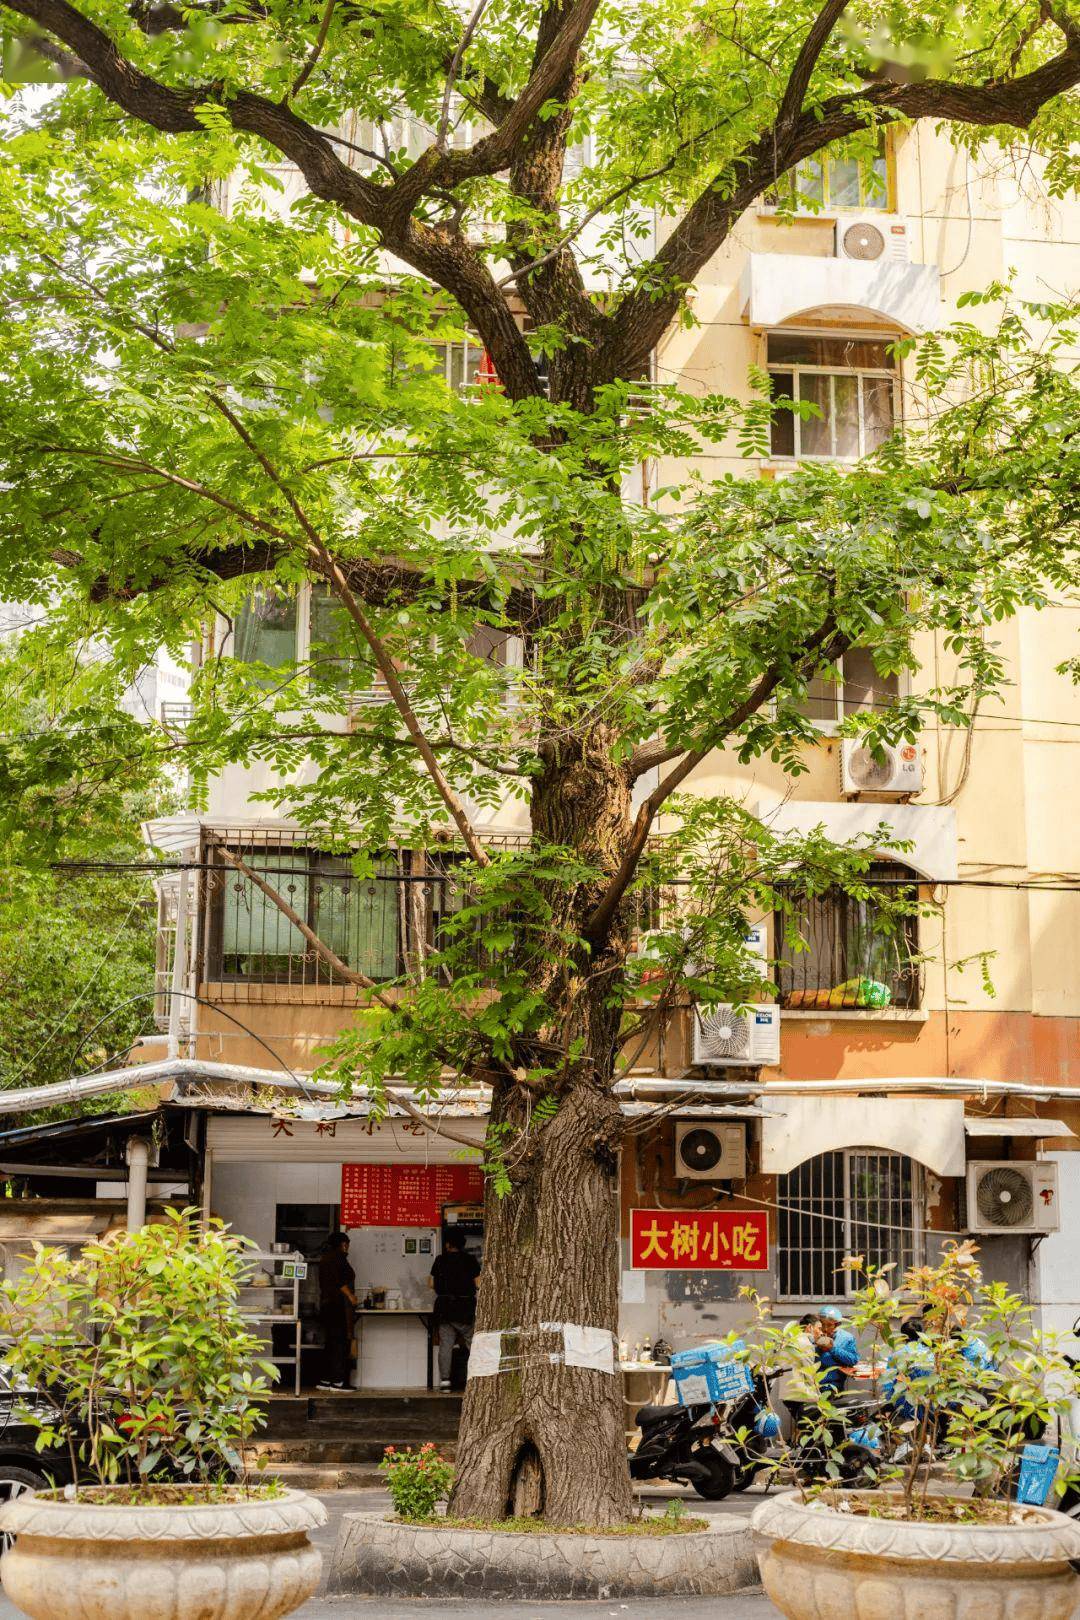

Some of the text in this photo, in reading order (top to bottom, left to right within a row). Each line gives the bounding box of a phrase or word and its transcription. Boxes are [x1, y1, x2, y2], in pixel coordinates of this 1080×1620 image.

[902, 764, 915, 772] LG
[271, 1119, 425, 1138] 大树小吃
[640, 1219, 761, 1261] 大树小吃
